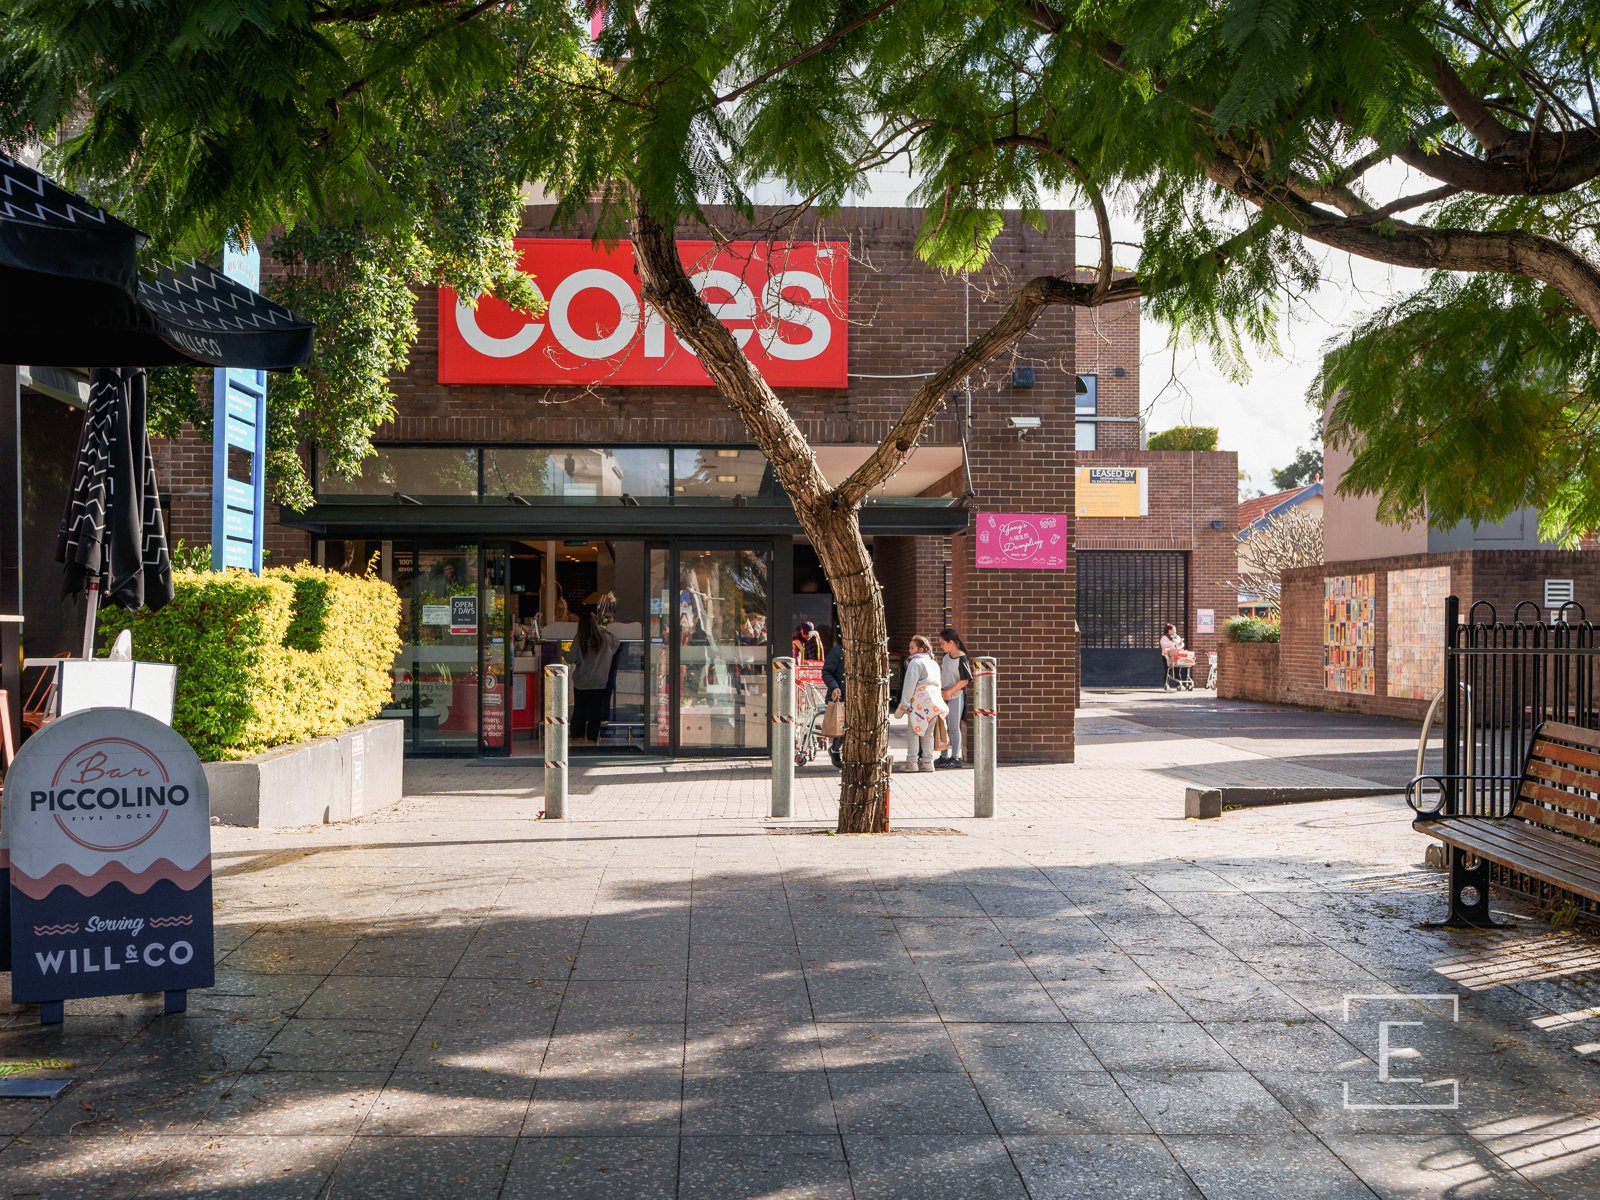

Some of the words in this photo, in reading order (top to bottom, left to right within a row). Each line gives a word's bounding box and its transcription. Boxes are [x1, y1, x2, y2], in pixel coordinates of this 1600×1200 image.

[1092, 469, 1122, 478] LEASED
[1124, 469, 1135, 478] BY
[1003, 538, 1044, 552] Dumpling
[399, 683, 433, 693] Sming
[70, 751, 150, 784] Bar
[31, 785, 189, 812] PICCOLINO
[84, 915, 145, 937] Serving
